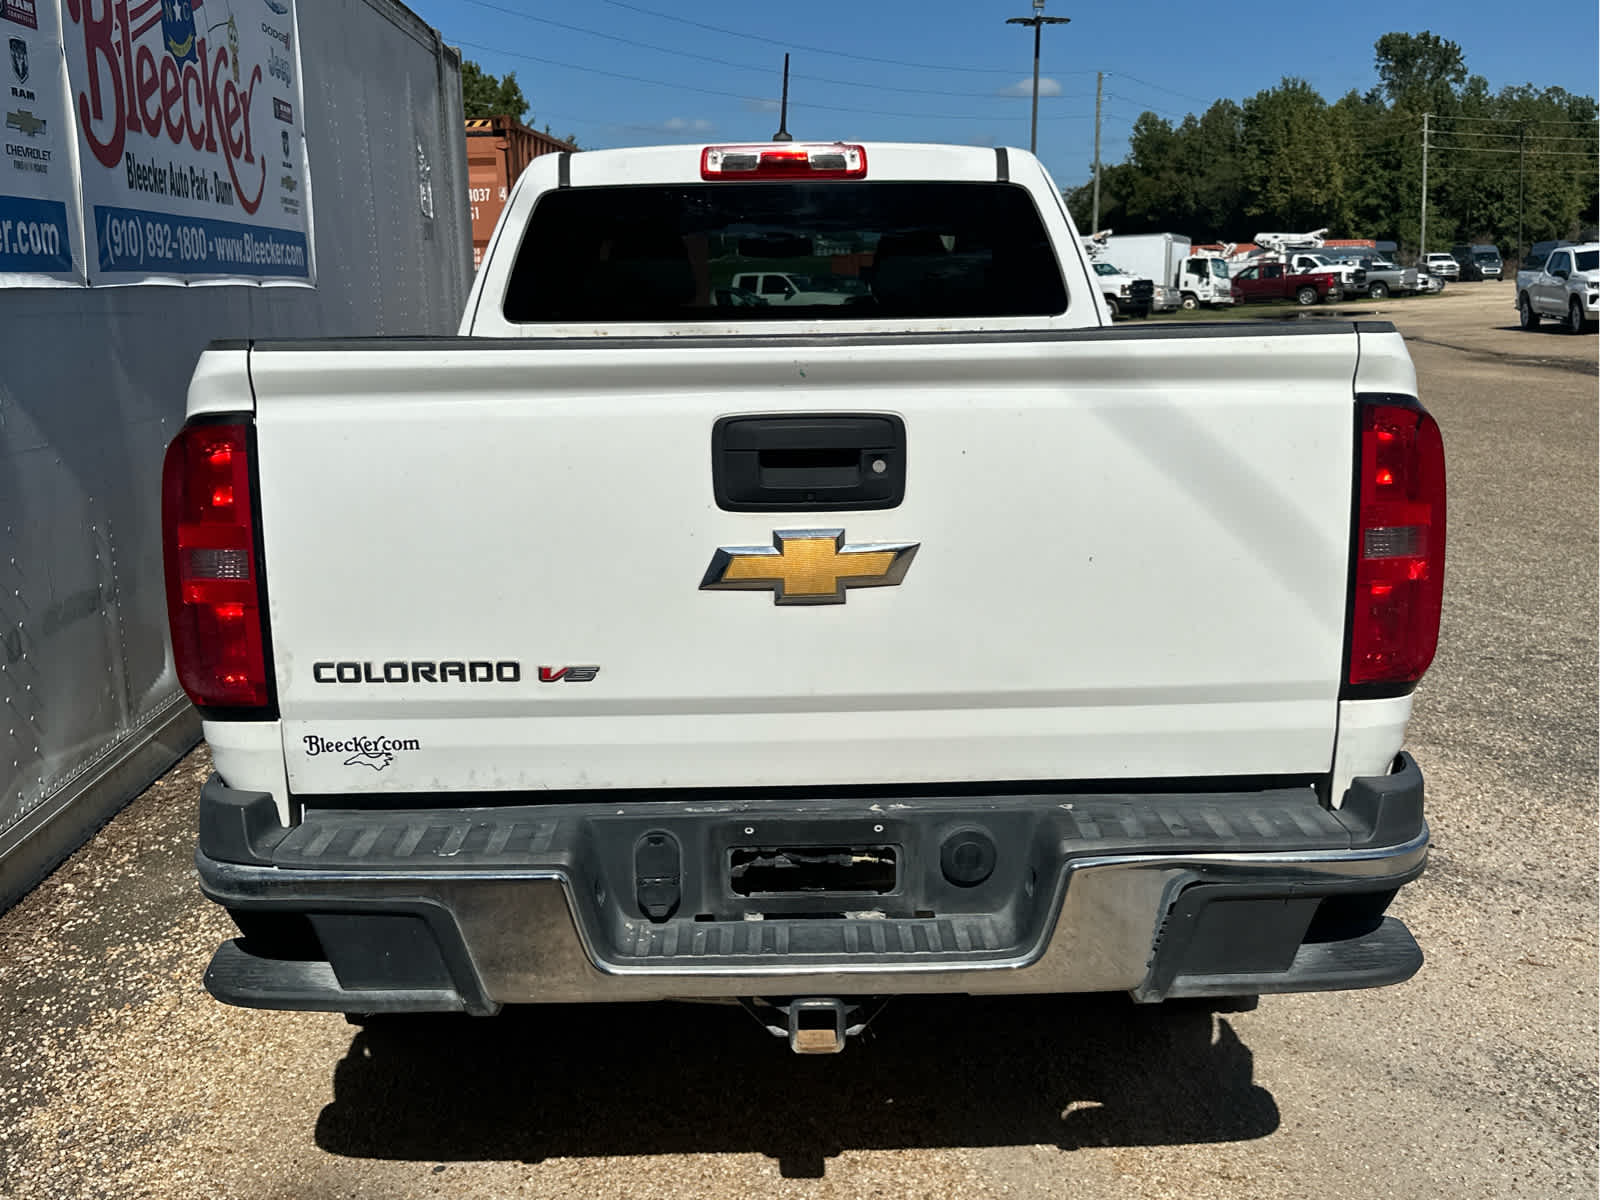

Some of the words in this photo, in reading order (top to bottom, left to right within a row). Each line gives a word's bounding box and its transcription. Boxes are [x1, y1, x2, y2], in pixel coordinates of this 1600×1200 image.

[11, 87, 35, 101] RAM
[5, 143, 51, 161] CHEVROLET
[125, 152, 168, 195] Bleecker
[169, 161, 189, 198] Auto
[189, 165, 209, 202] Park
[214, 171, 234, 206] Dunn
[0, 220, 60, 255] r.com
[106, 213, 143, 264] (910)
[146, 222, 207, 261] 892-1800
[215, 232, 304, 267] www.Bleecker.com
[313, 661, 520, 683] COLORADO
